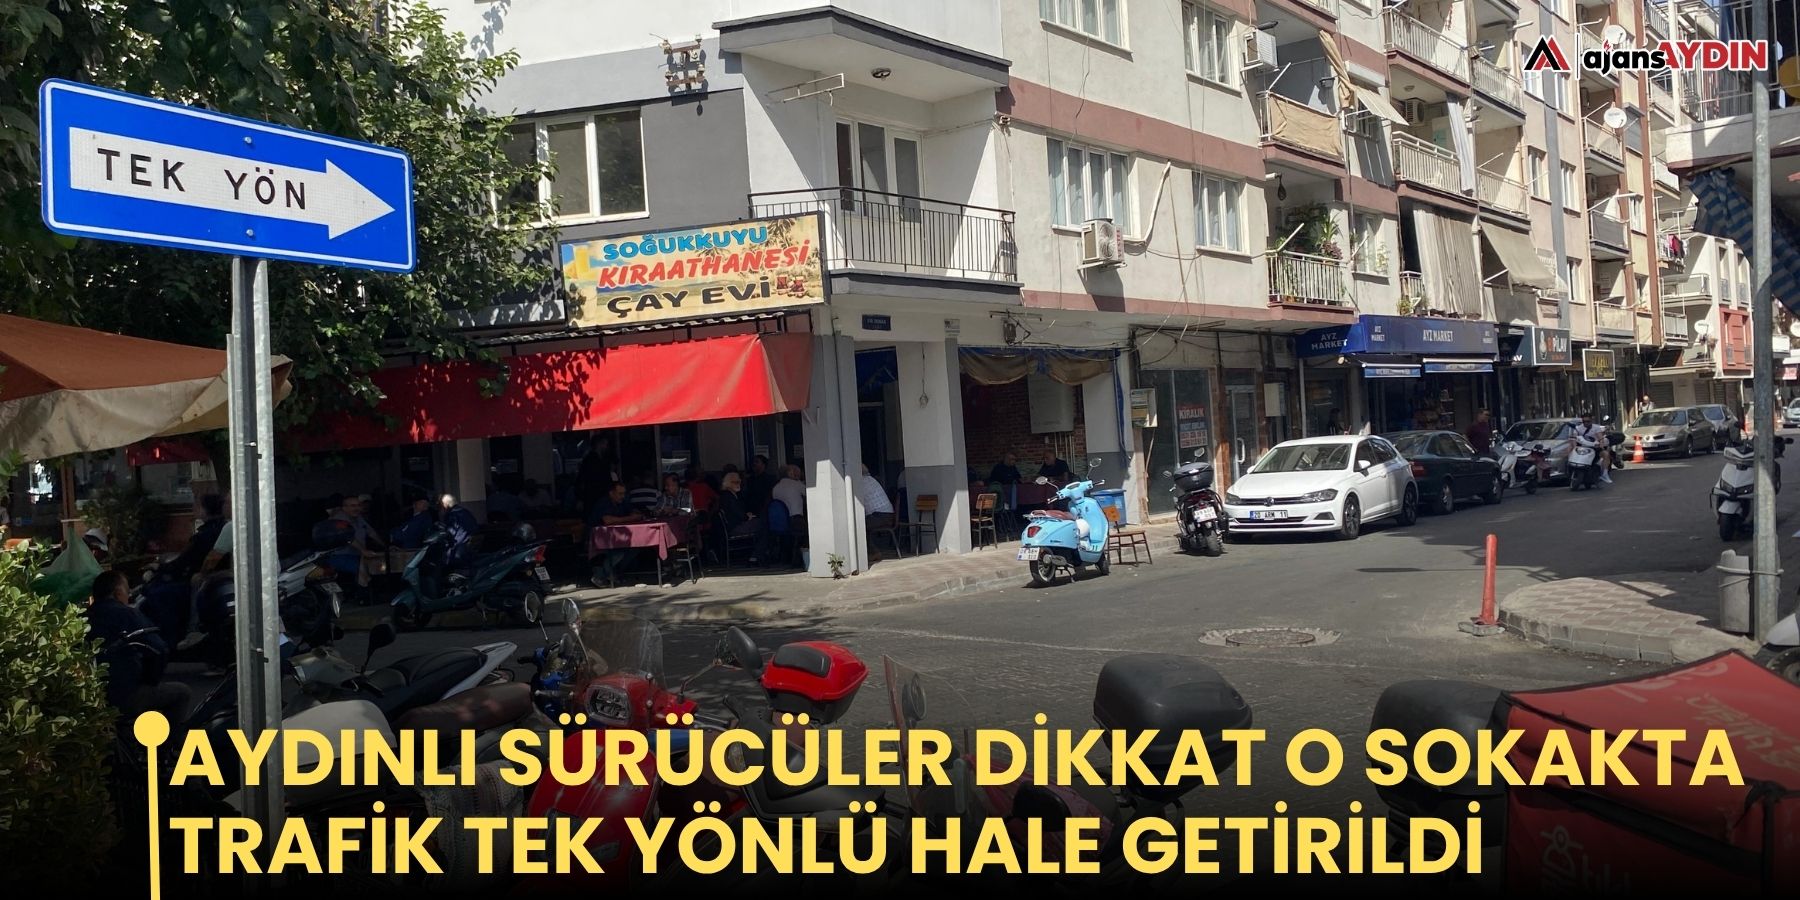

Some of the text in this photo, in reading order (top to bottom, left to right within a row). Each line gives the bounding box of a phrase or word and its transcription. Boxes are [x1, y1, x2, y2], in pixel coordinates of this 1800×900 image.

[98, 148, 306, 210] TEK YÖN
[603, 226, 768, 261] SOĞUKKUYU
[598, 239, 811, 288] KIRAATHANESİ
[607, 276, 770, 319] ÇAY EVİ
[1311, 339, 1348, 350] MARKET
[1320, 332, 1337, 341] AYZ
[1423, 329, 1453, 342] AYZ MARKET
